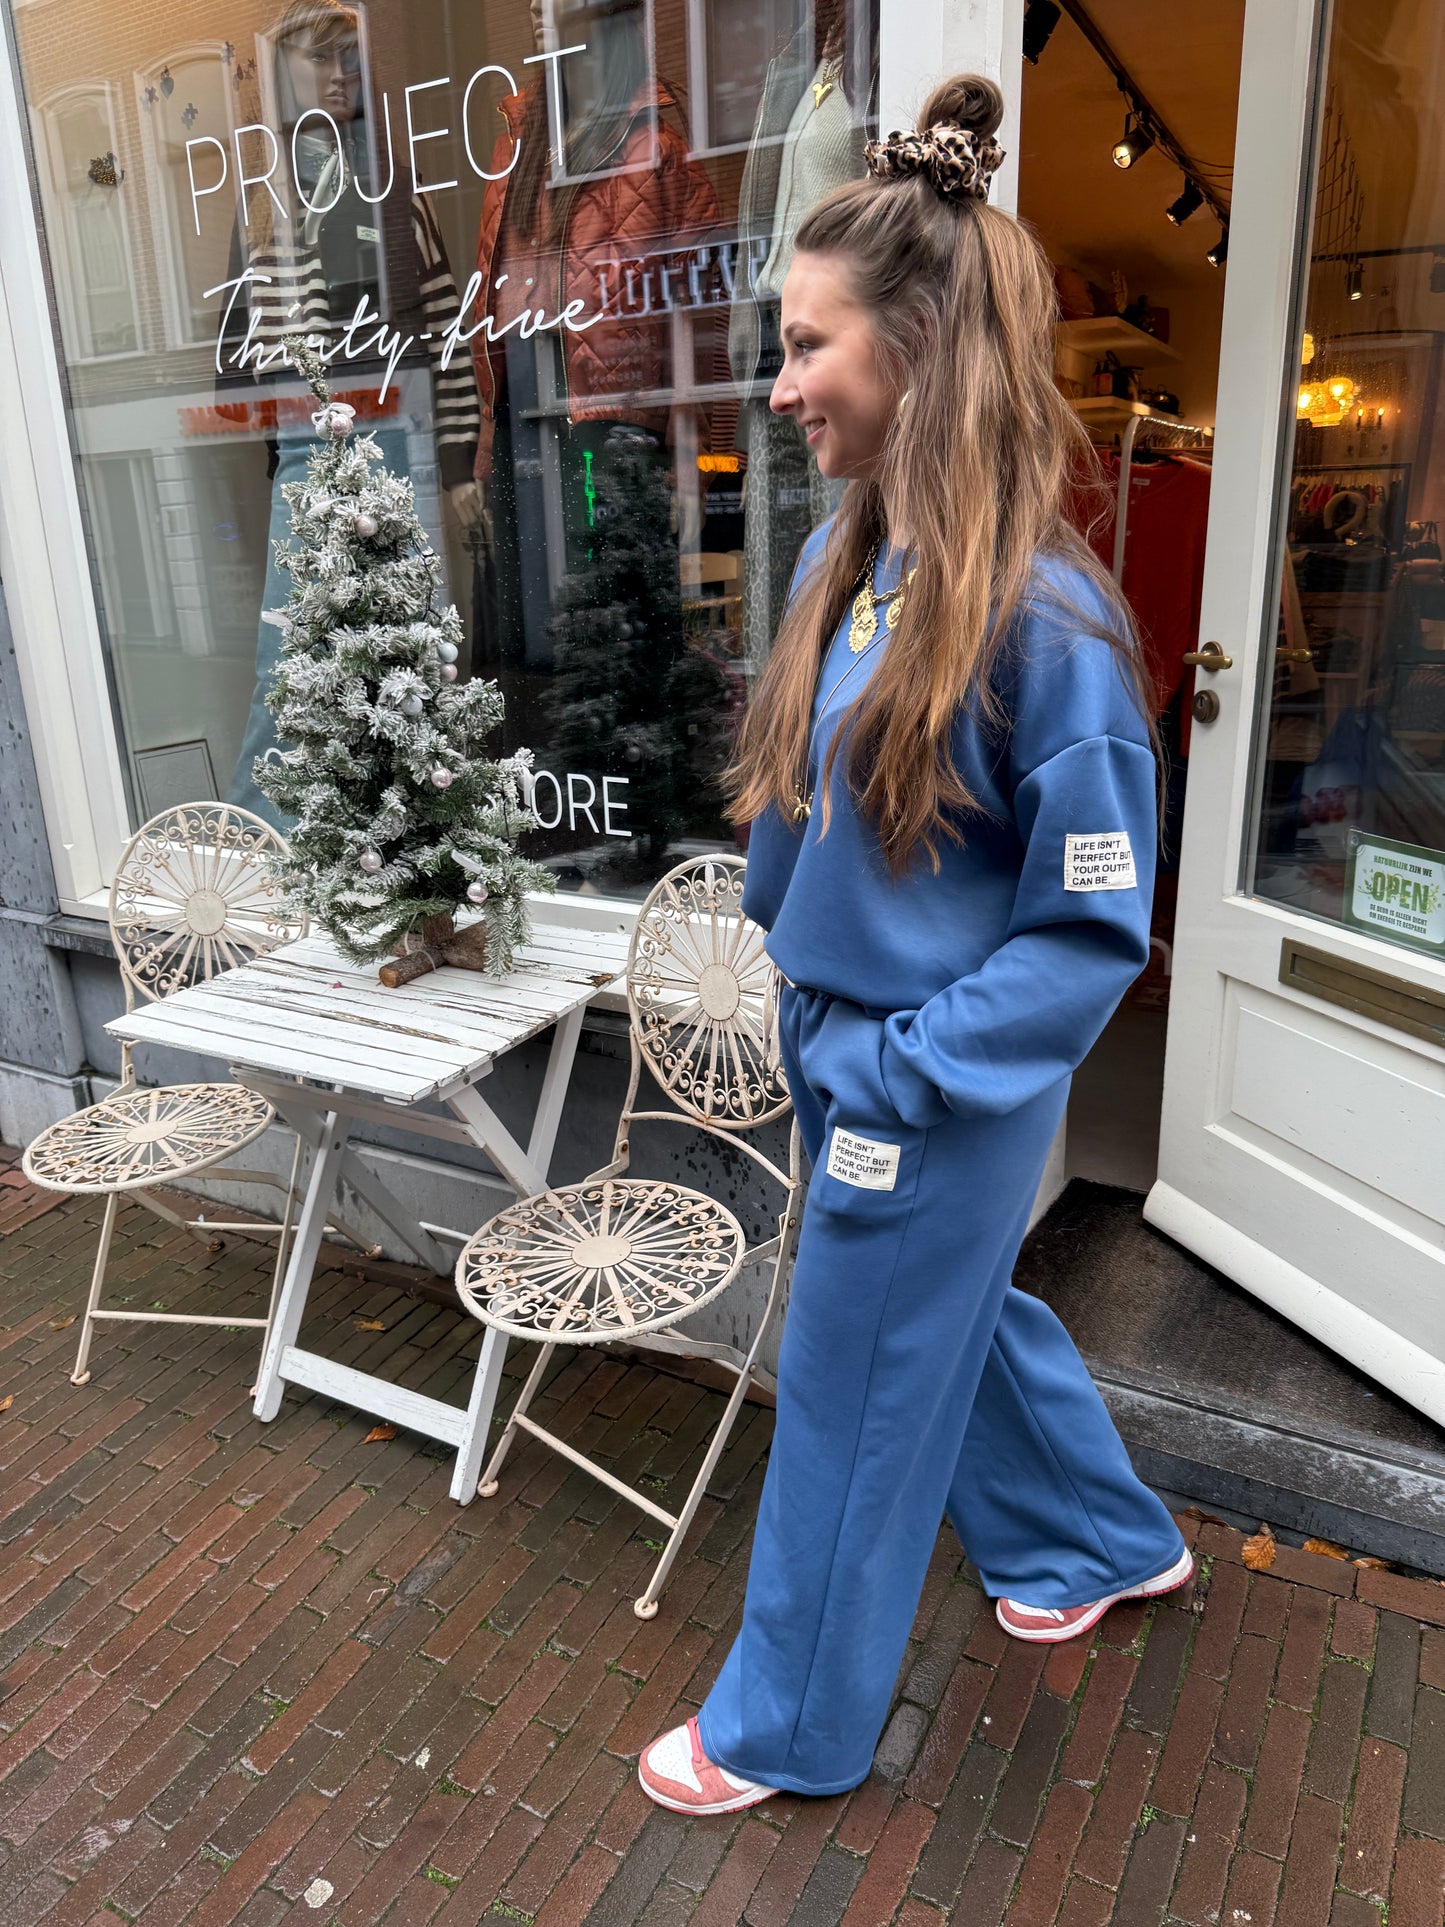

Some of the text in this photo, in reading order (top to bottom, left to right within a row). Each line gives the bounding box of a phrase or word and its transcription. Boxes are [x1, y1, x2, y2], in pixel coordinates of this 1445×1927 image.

[185, 44, 587, 236] PROJECT
[203, 267, 605, 405] Thirty-five
[1074, 841, 1120, 850] LIFE ISN'T
[1074, 851, 1131, 862] PERFECT BUT
[1073, 863, 1130, 874] YOUR OUTFIT
[1423, 868, 1432, 877] WE
[1095, 876, 1110, 884] BE.
[1372, 872, 1429, 914] OPEN
[838, 1135, 875, 1153] LIFE ISN'T
[836, 1145, 891, 1166] PERFECT BUT
[833, 1165, 847, 1176] CAN
[834, 1155, 886, 1175] YOUR OUTFIT
